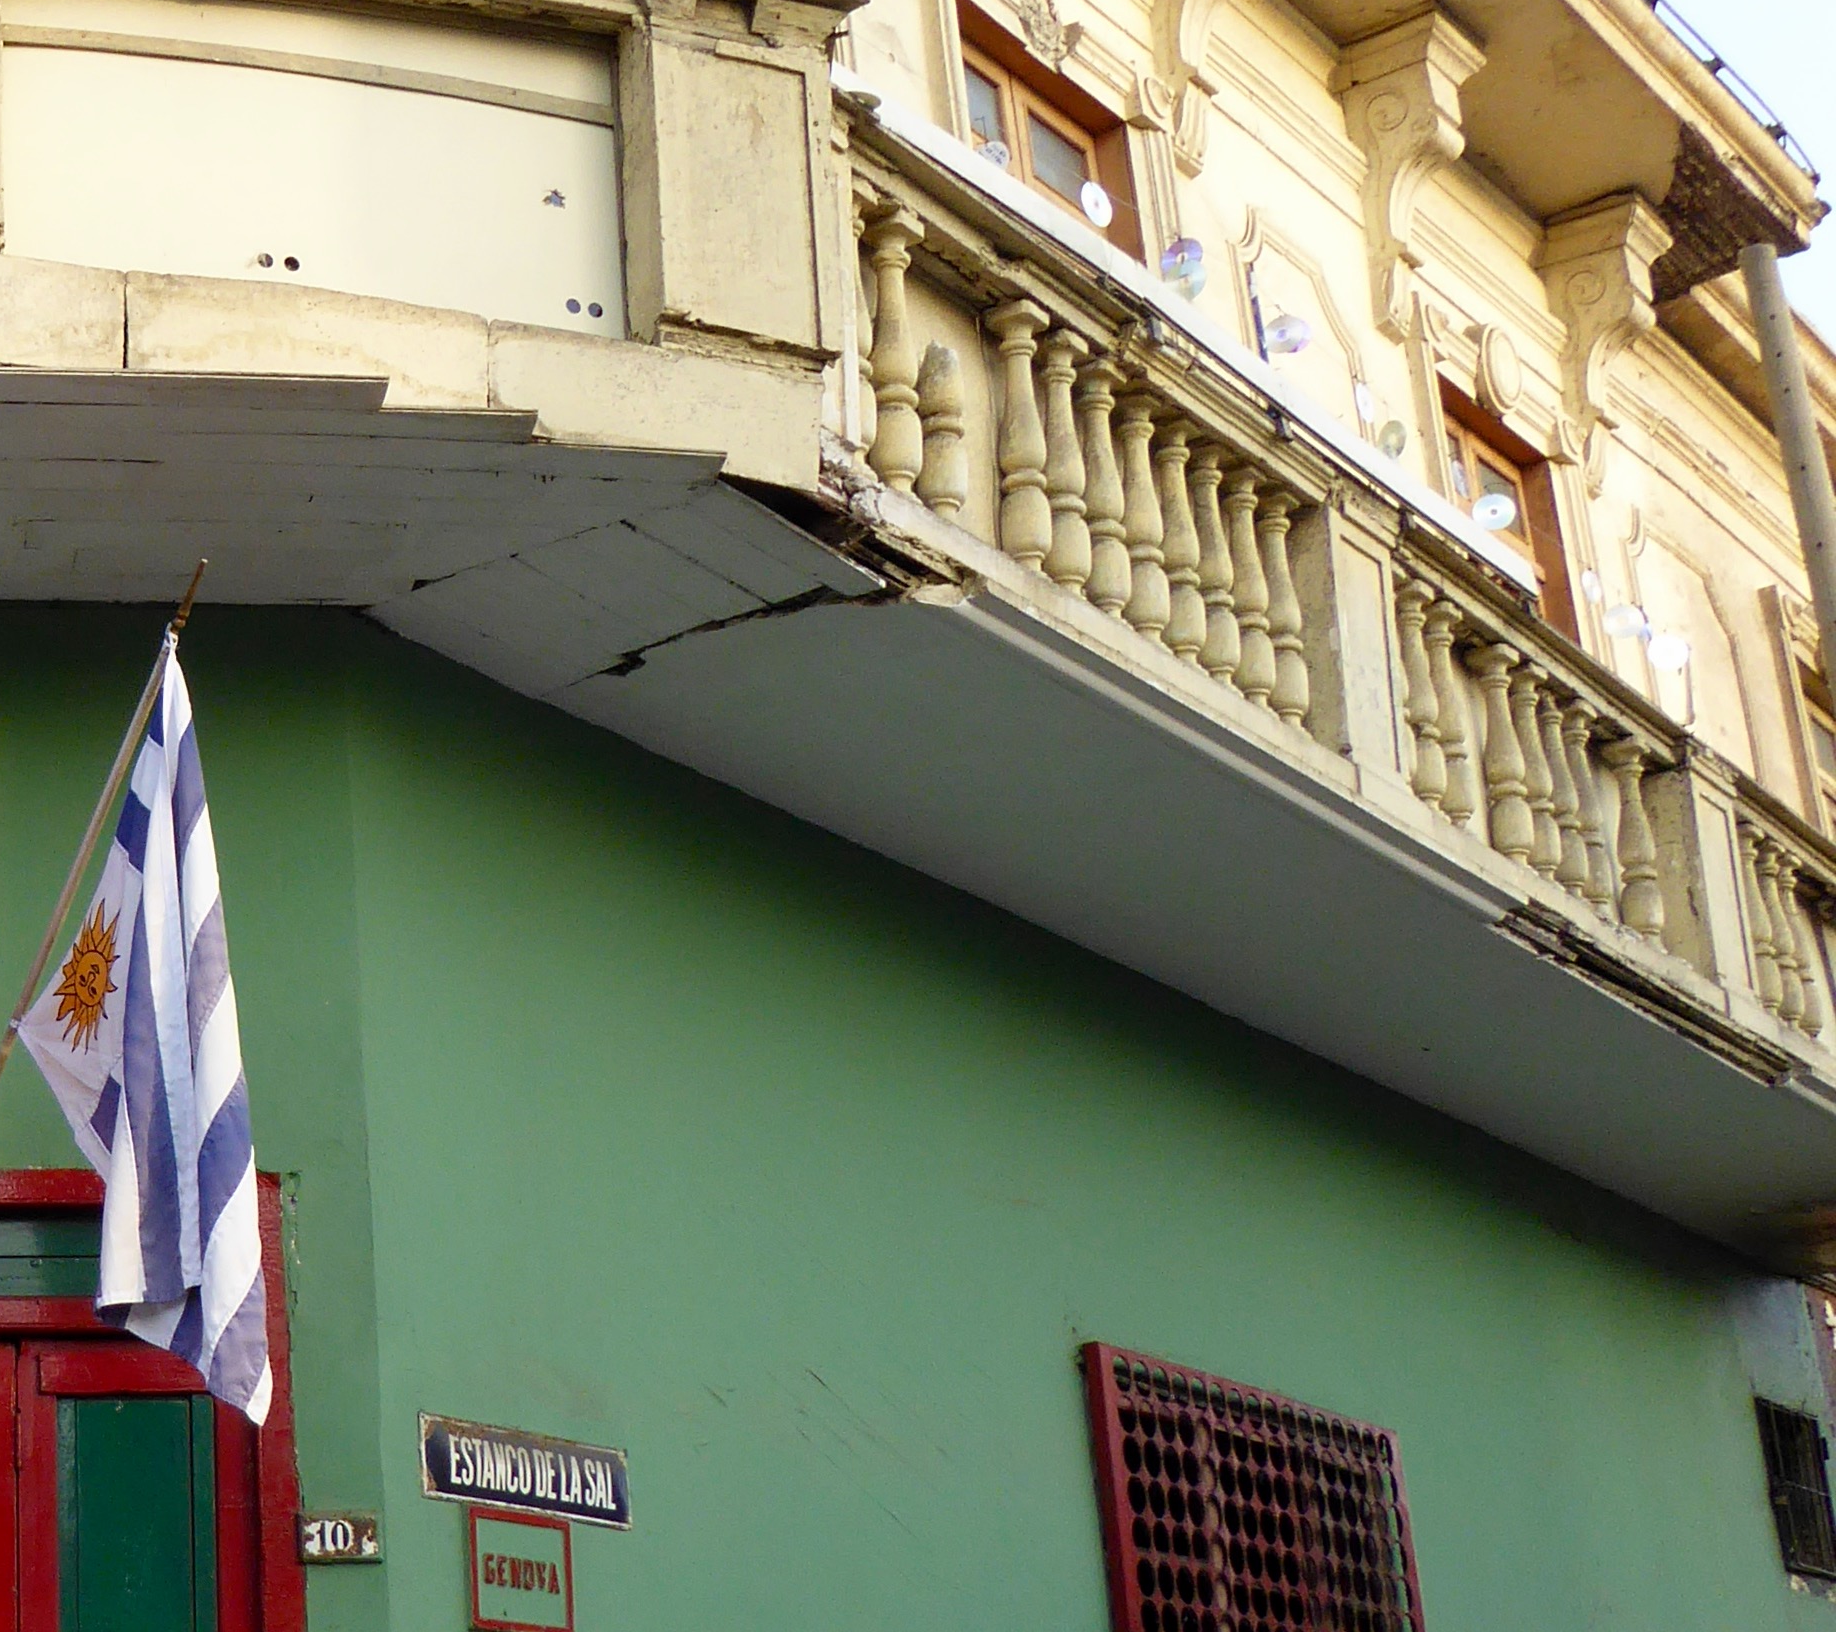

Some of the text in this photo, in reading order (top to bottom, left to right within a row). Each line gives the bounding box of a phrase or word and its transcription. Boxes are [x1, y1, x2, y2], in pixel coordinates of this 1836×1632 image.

[448, 1434, 617, 1510] ESTANCO DE LA SAL
[482, 1553, 561, 1594] GENOVA
